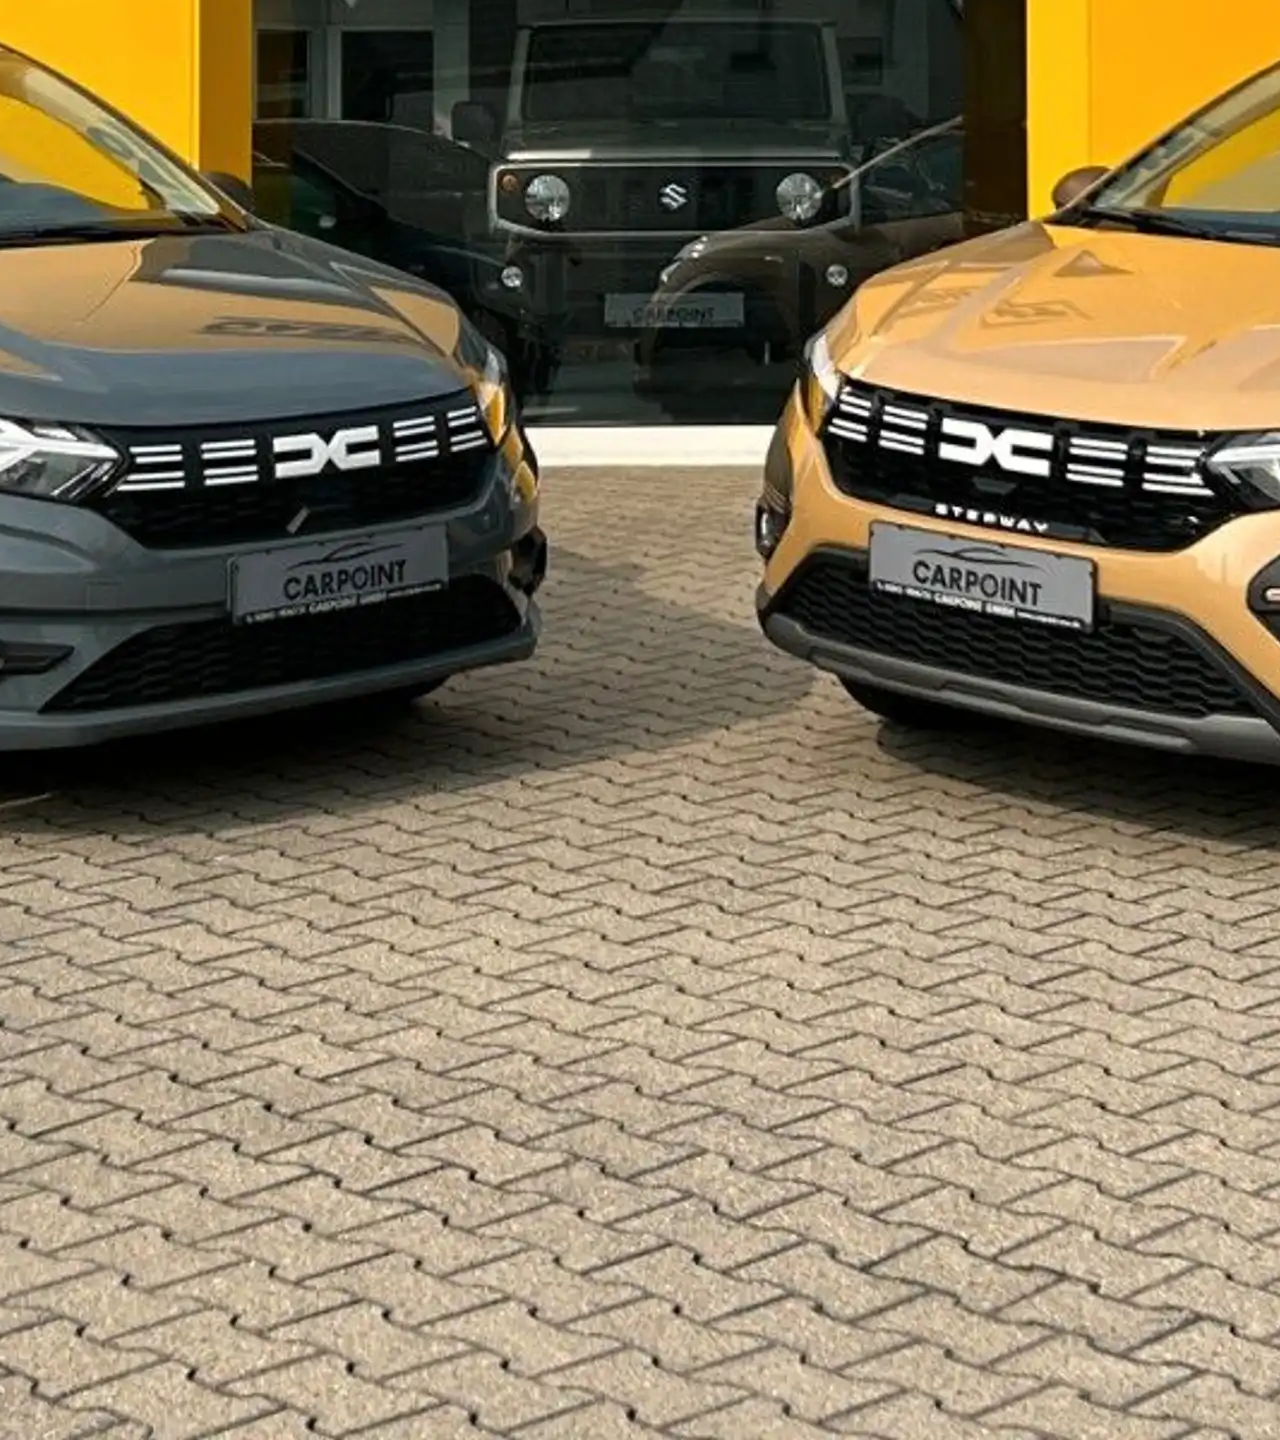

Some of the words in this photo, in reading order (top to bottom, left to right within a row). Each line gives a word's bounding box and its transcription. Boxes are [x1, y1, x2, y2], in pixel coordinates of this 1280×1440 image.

[934, 503, 1049, 533] STEPWAY
[282, 559, 408, 601] CARPOINT
[912, 560, 1043, 607] CARPOINT
